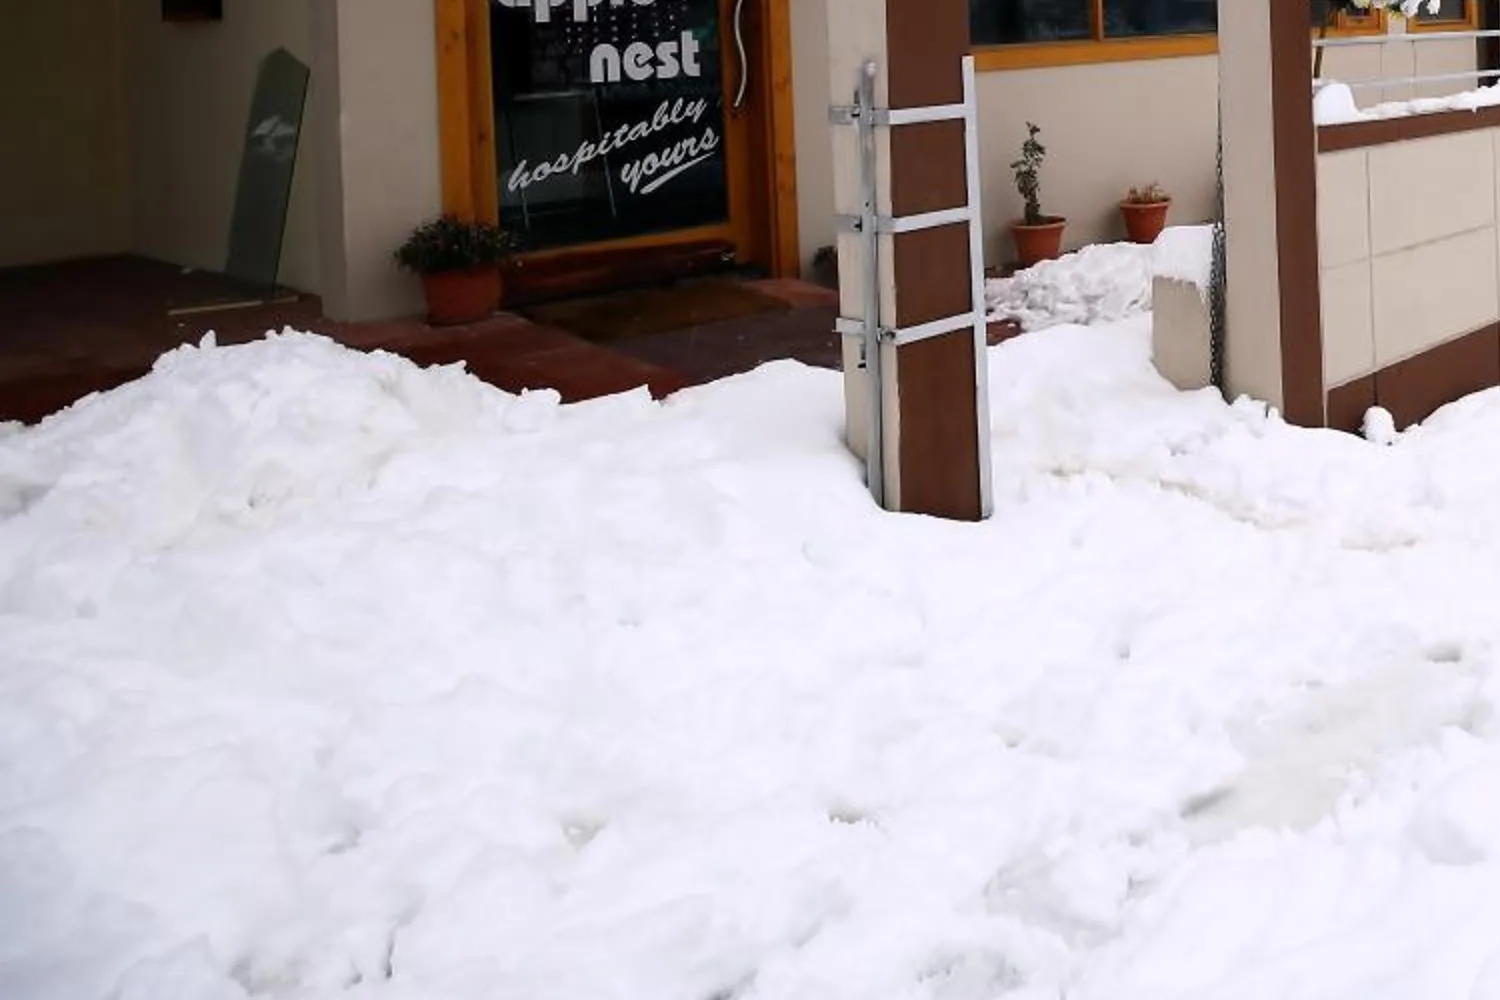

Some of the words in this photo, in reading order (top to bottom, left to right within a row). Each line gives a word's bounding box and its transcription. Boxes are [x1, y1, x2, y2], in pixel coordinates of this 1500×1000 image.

[590, 30, 701, 83] nest
[508, 98, 707, 192] hospitably
[621, 127, 719, 193] yours
